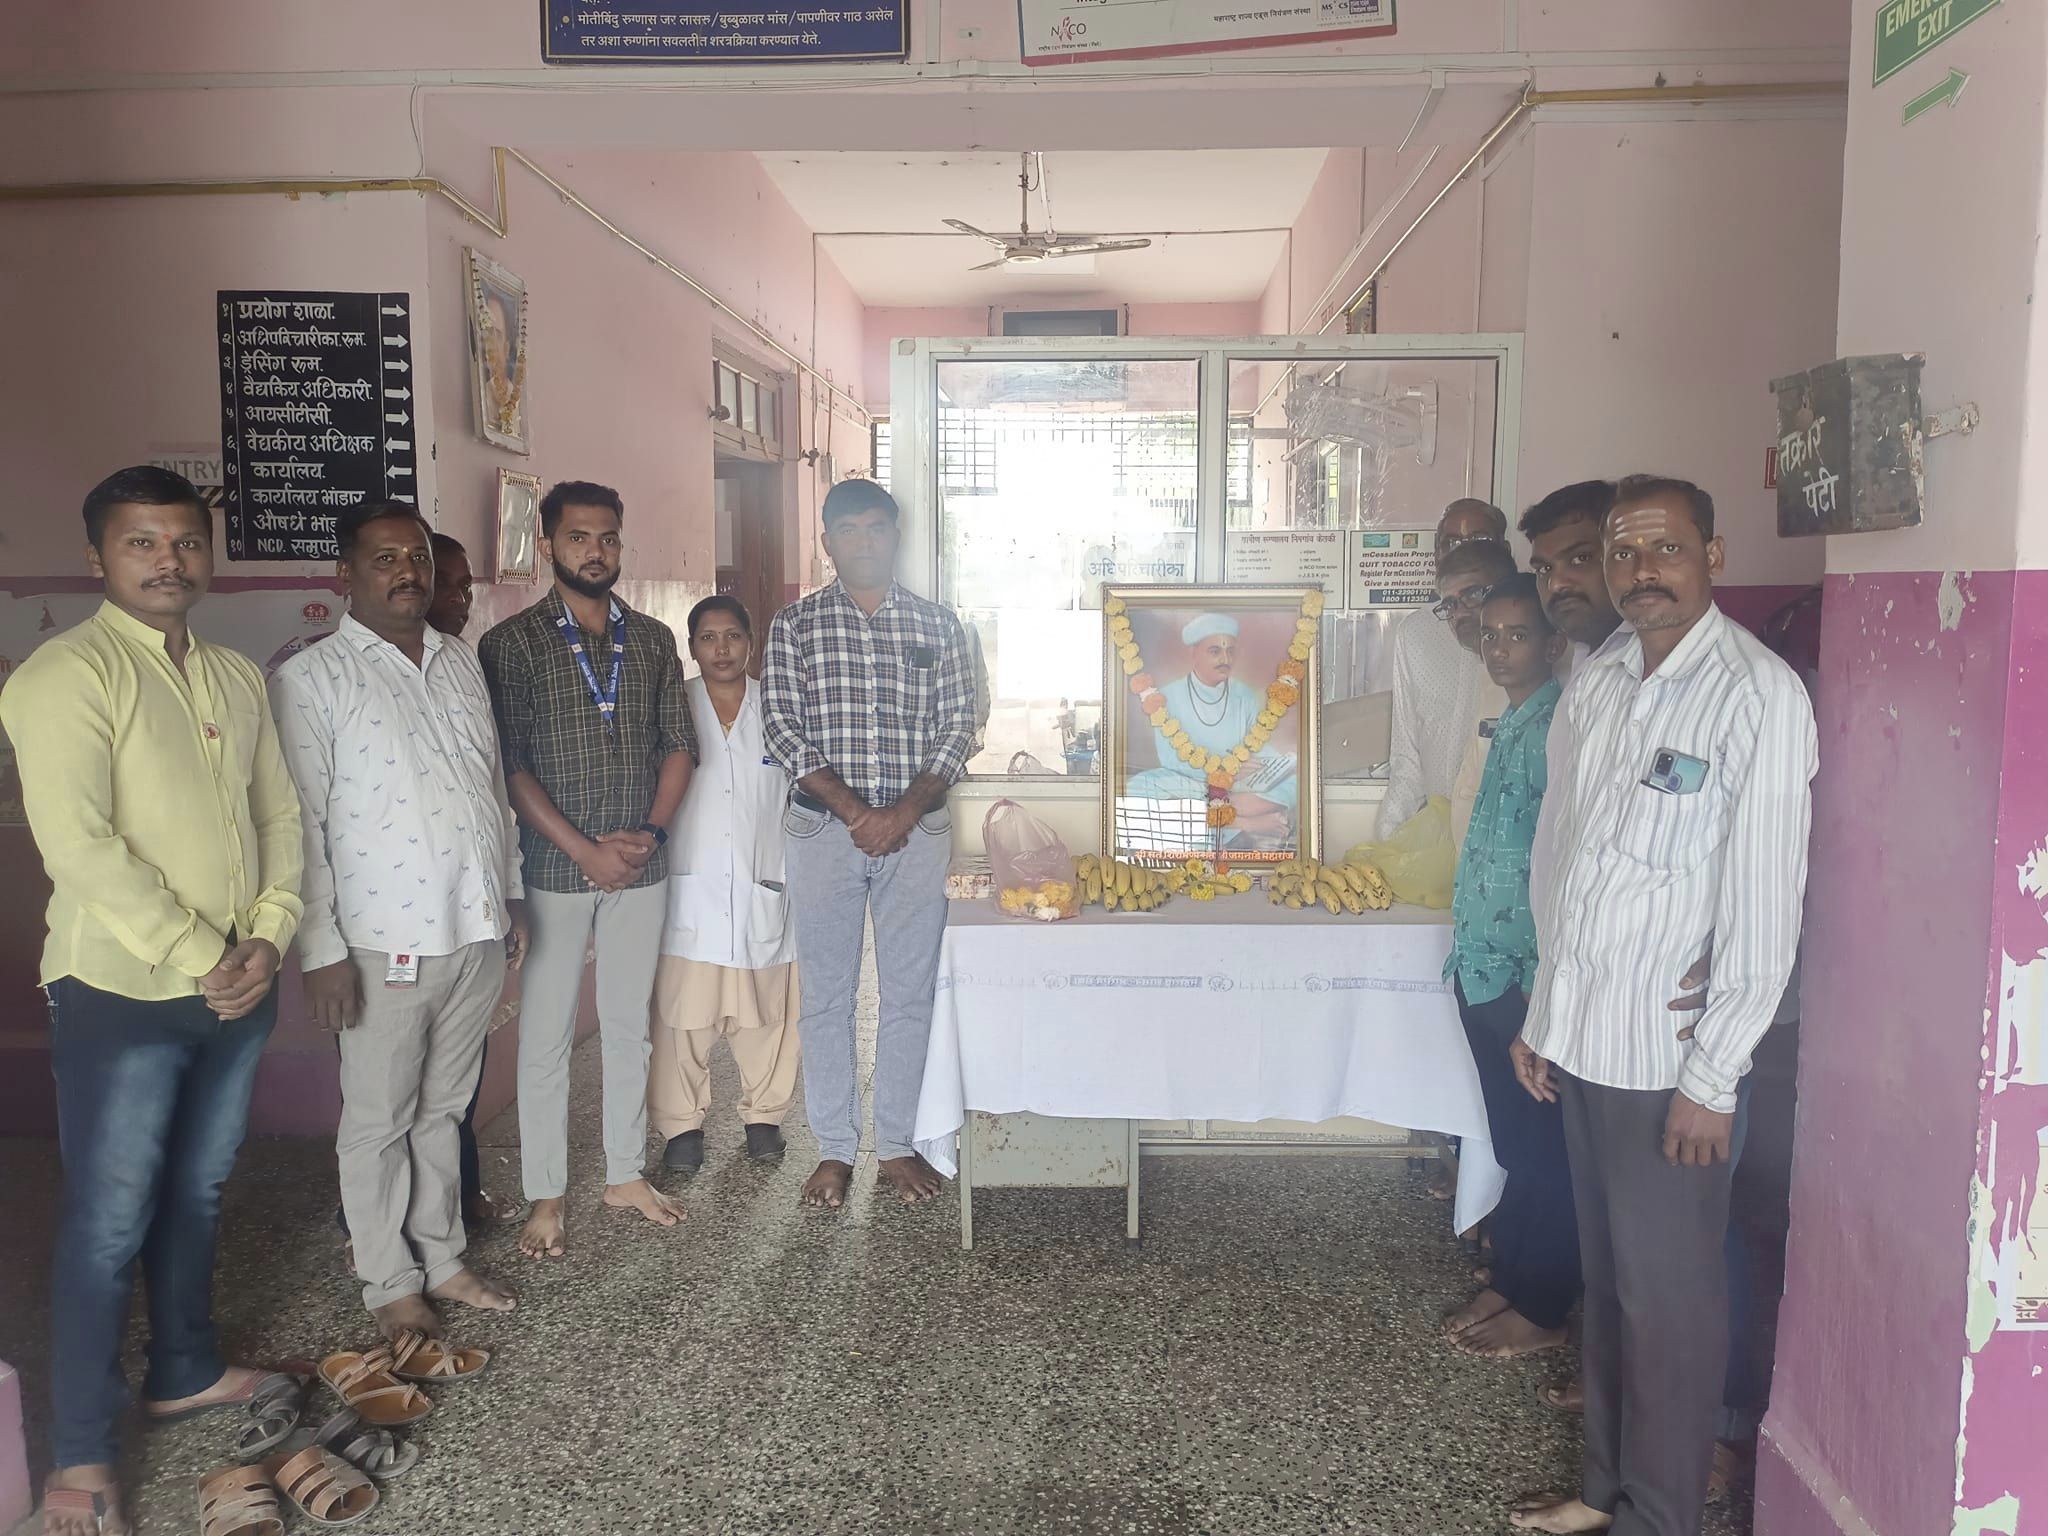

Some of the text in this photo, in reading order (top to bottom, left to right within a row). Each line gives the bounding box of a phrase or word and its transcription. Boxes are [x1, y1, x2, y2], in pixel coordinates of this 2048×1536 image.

[578, 11, 619, 28] मोतीबिंदु
[660, 14, 676, 25] जर
[843, 11, 862, 22] गाठ
[865, 6, 893, 22] असेल
[1886, 0, 1932, 38] EME
[1917, 0, 1952, 46] EXIT
[581, 35, 595, 47] तर
[598, 35, 620, 47] अशा
[662, 32, 708, 47] सवलतीत
[759, 34, 799, 46] करण्यात
[237, 297, 291, 320] प्रयोग
[151, 460, 221, 479] NTRY
[250, 482, 319, 505] कार्यालय
[1802, 466, 1839, 517] पेटी
